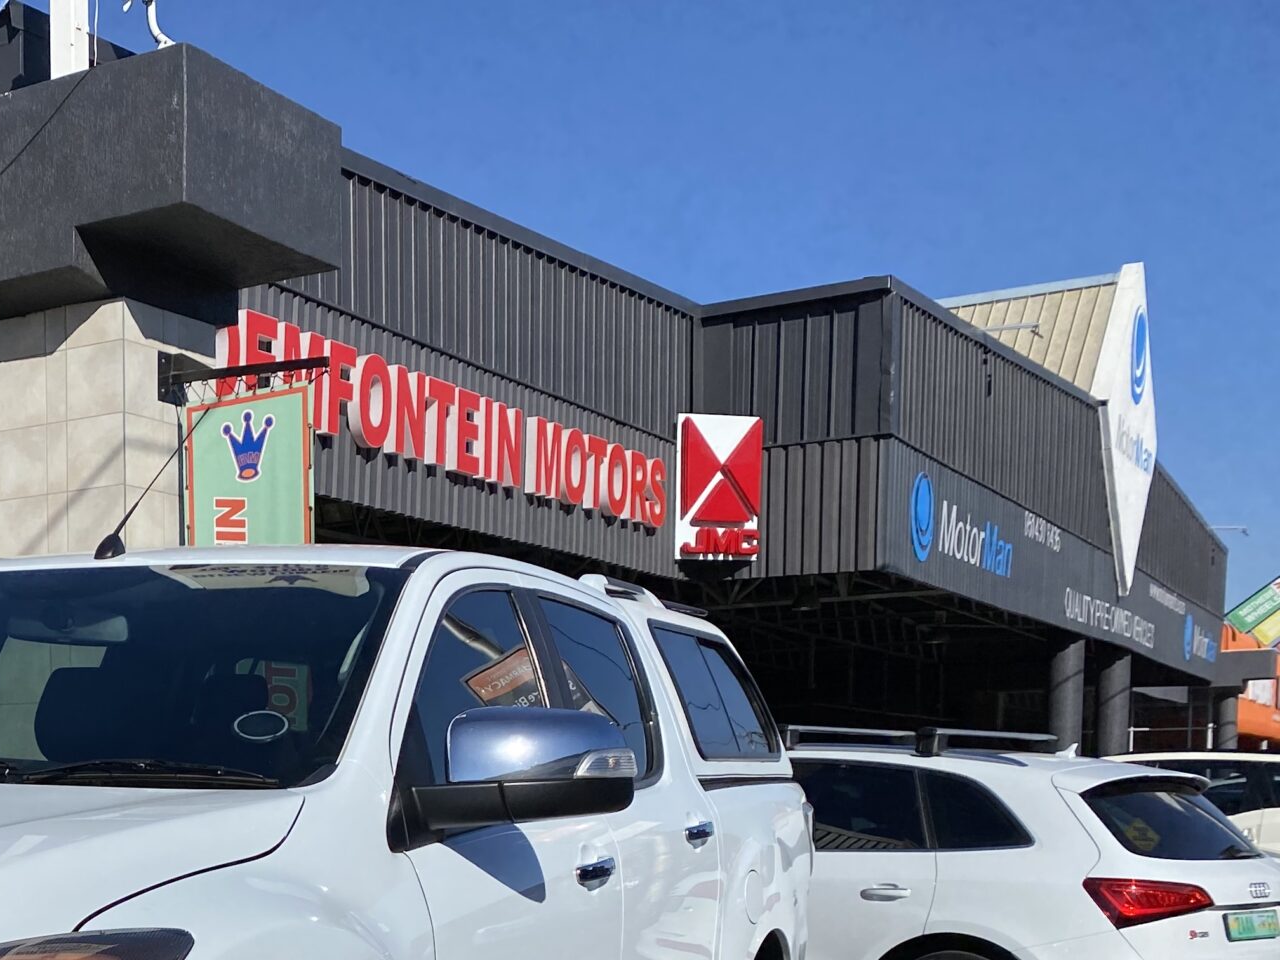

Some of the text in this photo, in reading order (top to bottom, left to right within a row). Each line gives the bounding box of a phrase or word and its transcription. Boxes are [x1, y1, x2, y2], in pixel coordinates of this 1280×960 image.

[216, 308, 667, 528] EMFONTEIN MOTORS
[680, 528, 760, 558] JMC
[938, 500, 1013, 578] MotorMan
[1064, 587, 1096, 626] QUALITY
